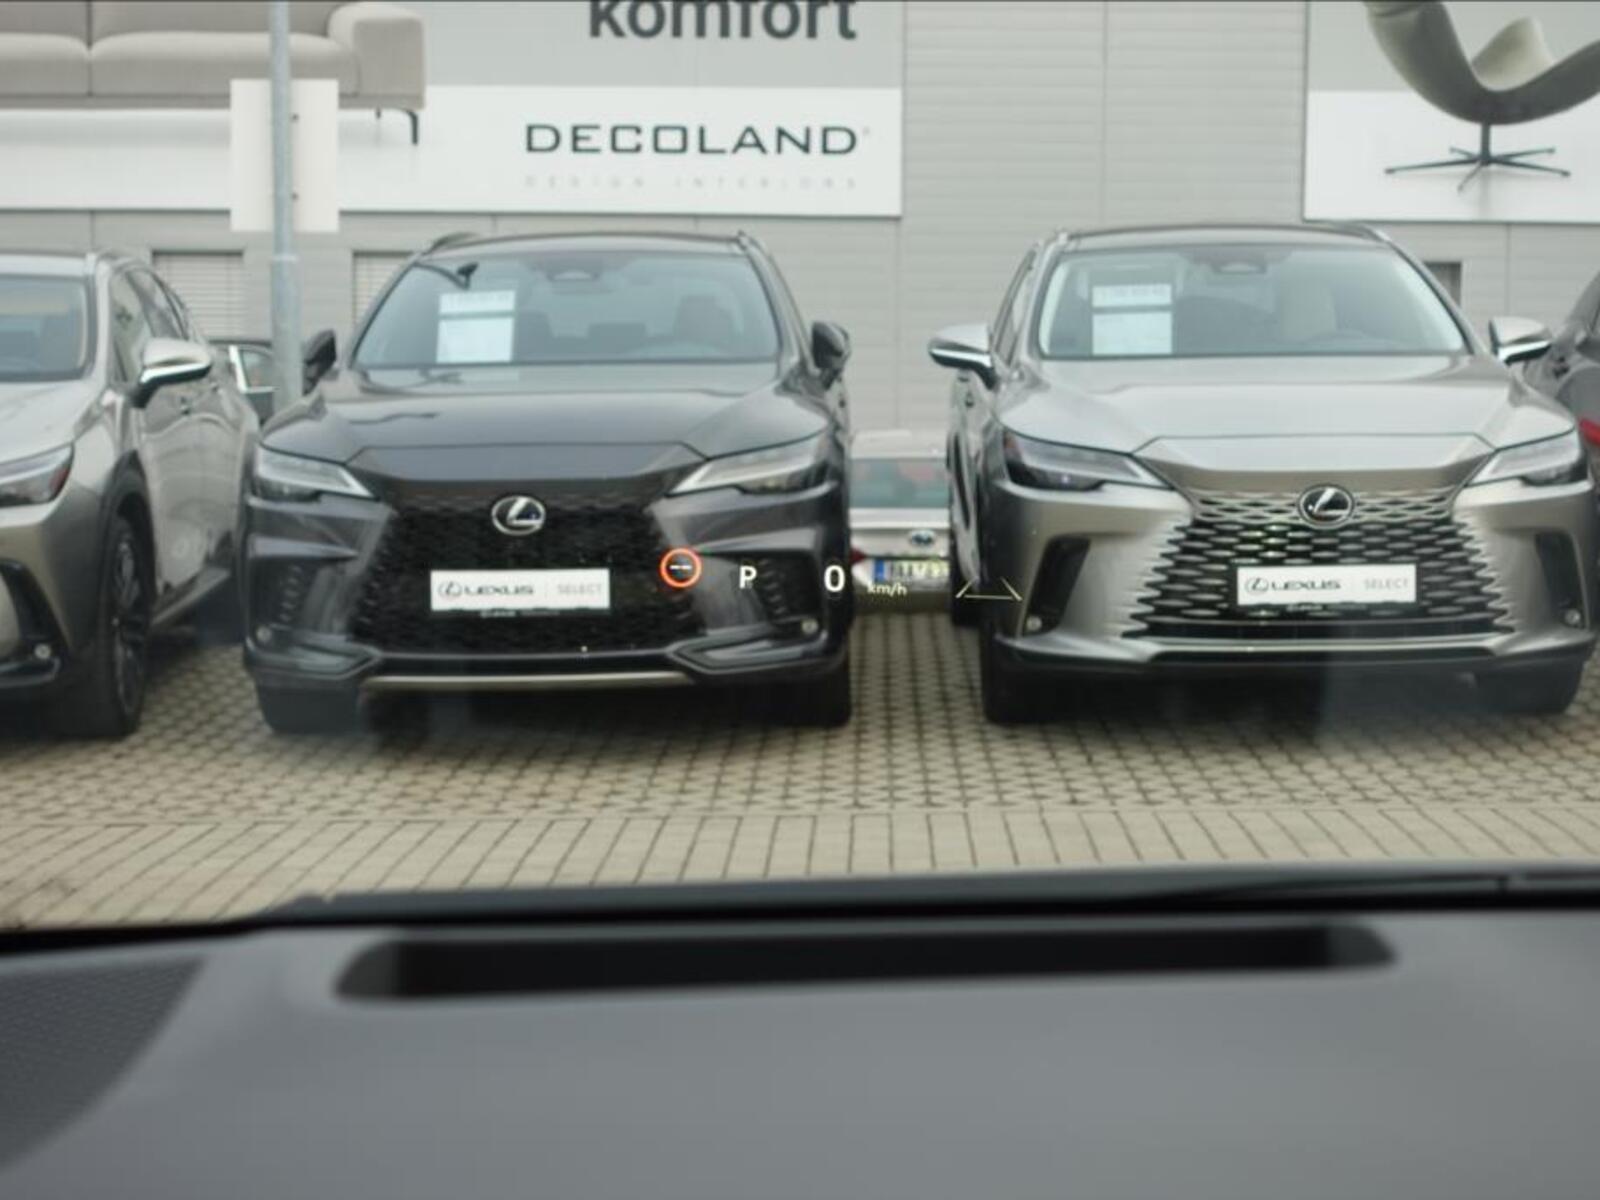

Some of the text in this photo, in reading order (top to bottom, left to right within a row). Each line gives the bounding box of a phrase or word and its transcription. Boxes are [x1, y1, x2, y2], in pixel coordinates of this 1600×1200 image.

[589, 1, 857, 40] komfort
[525, 124, 858, 155] DECOLAND
[464, 584, 602, 596] LEXUS SELECT
[739, 565, 757, 589] P
[824, 565, 908, 597] 0 km/h
[1272, 578, 1409, 591] LEXUS SELECT
